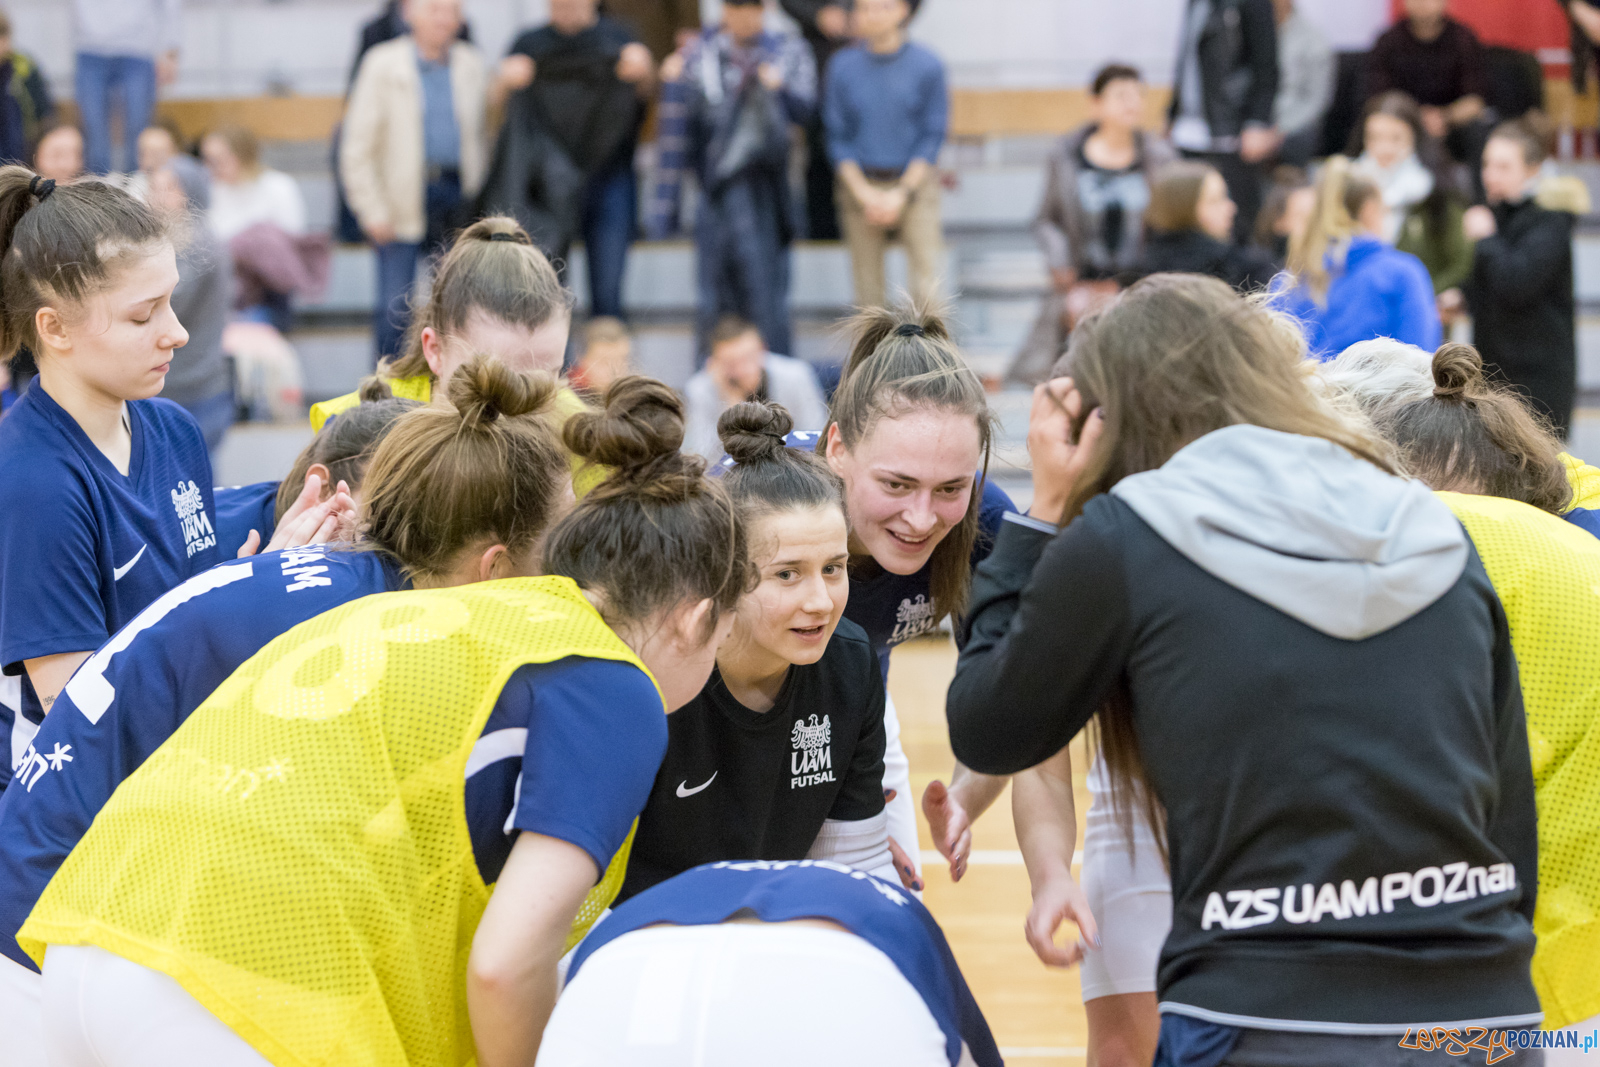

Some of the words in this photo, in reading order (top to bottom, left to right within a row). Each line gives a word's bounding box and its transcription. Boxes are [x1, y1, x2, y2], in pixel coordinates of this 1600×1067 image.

[791, 745, 832, 775] UAM
[791, 770, 837, 790] FUTSAL
[1201, 887, 1280, 931] AZS
[1281, 875, 1380, 924] UAM
